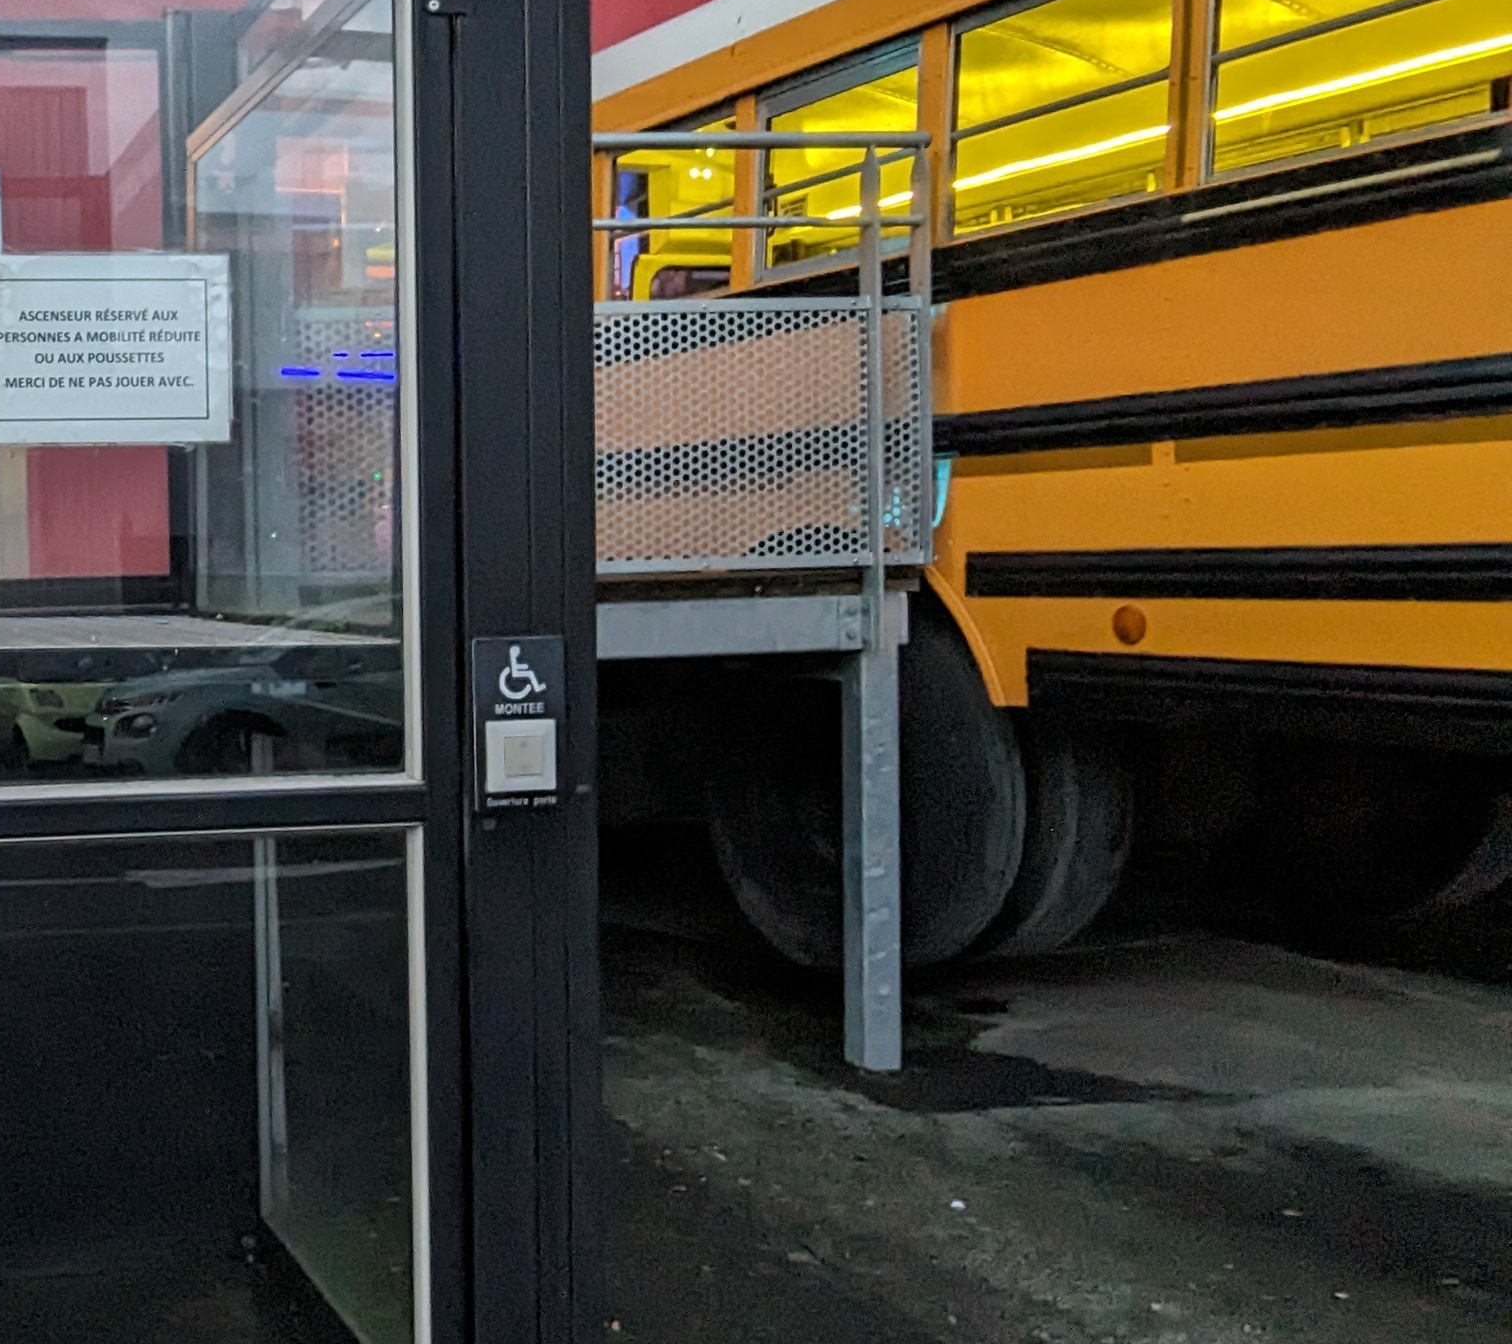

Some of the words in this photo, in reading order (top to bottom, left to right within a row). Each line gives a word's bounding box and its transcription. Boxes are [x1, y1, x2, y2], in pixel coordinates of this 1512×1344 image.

[18, 309, 92, 322] ASCENSEUR
[95, 307, 149, 322] RÉSERVÉ
[152, 310, 178, 322] AUX
[73, 331, 84, 343] A
[86, 329, 146, 343] MOBILITÉ
[148, 329, 201, 342] RÉDUITE
[34, 352, 55, 365] OU
[57, 352, 85, 365] AUX
[87, 351, 165, 365] POUSSETTES
[4, 376, 46, 389] MERCI
[48, 376, 66, 389] DE
[68, 376, 86, 388] NE
[88, 376, 113, 388] PAS
[114, 376, 155, 388] JOUER
[158, 375, 195, 388] AVEC.
[494, 702, 545, 715] MONTEE
